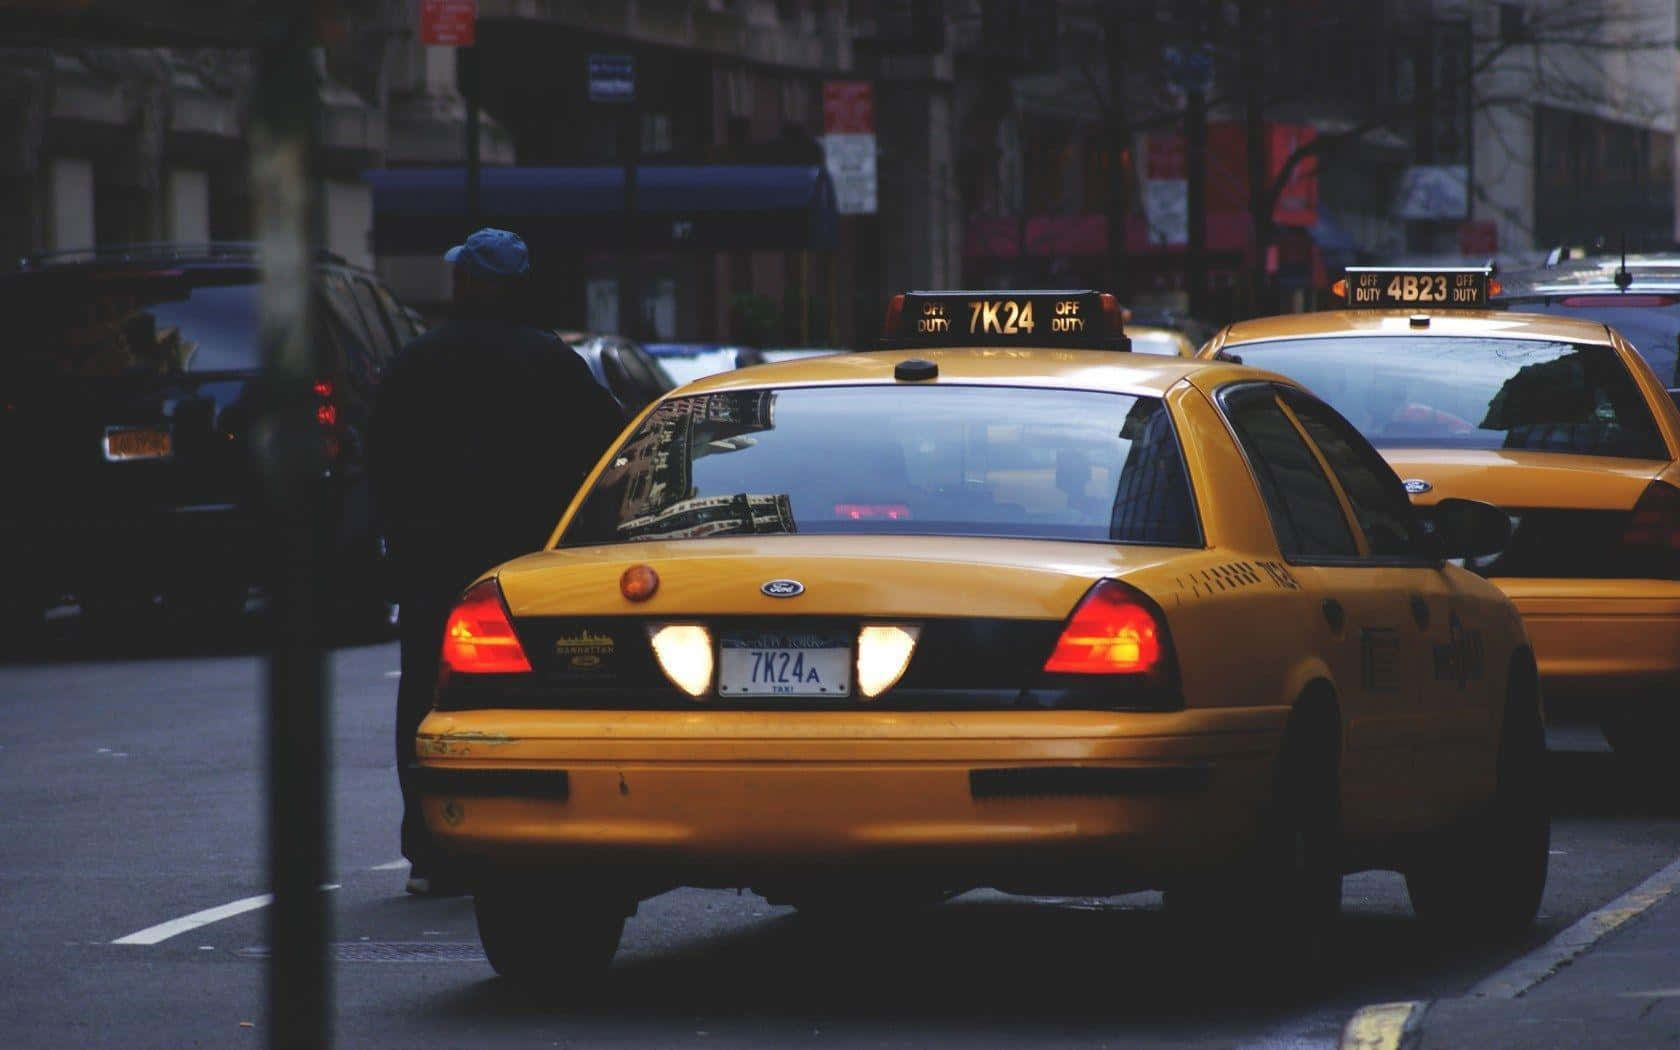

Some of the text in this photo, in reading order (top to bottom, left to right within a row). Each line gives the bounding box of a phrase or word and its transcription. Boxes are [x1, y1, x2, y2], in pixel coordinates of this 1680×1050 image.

[1360, 275, 1378, 287] OFF
[1456, 275, 1474, 287] OFF
[1356, 288, 1381, 301] DUTY
[1387, 275, 1447, 301] 4B23
[1453, 288, 1477, 301] DUTY
[922, 302, 945, 315] OFF
[1055, 301, 1080, 315] OFF
[968, 301, 1034, 334] 7K24
[918, 318, 950, 332] DUTY
[1052, 318, 1085, 332] DUTY
